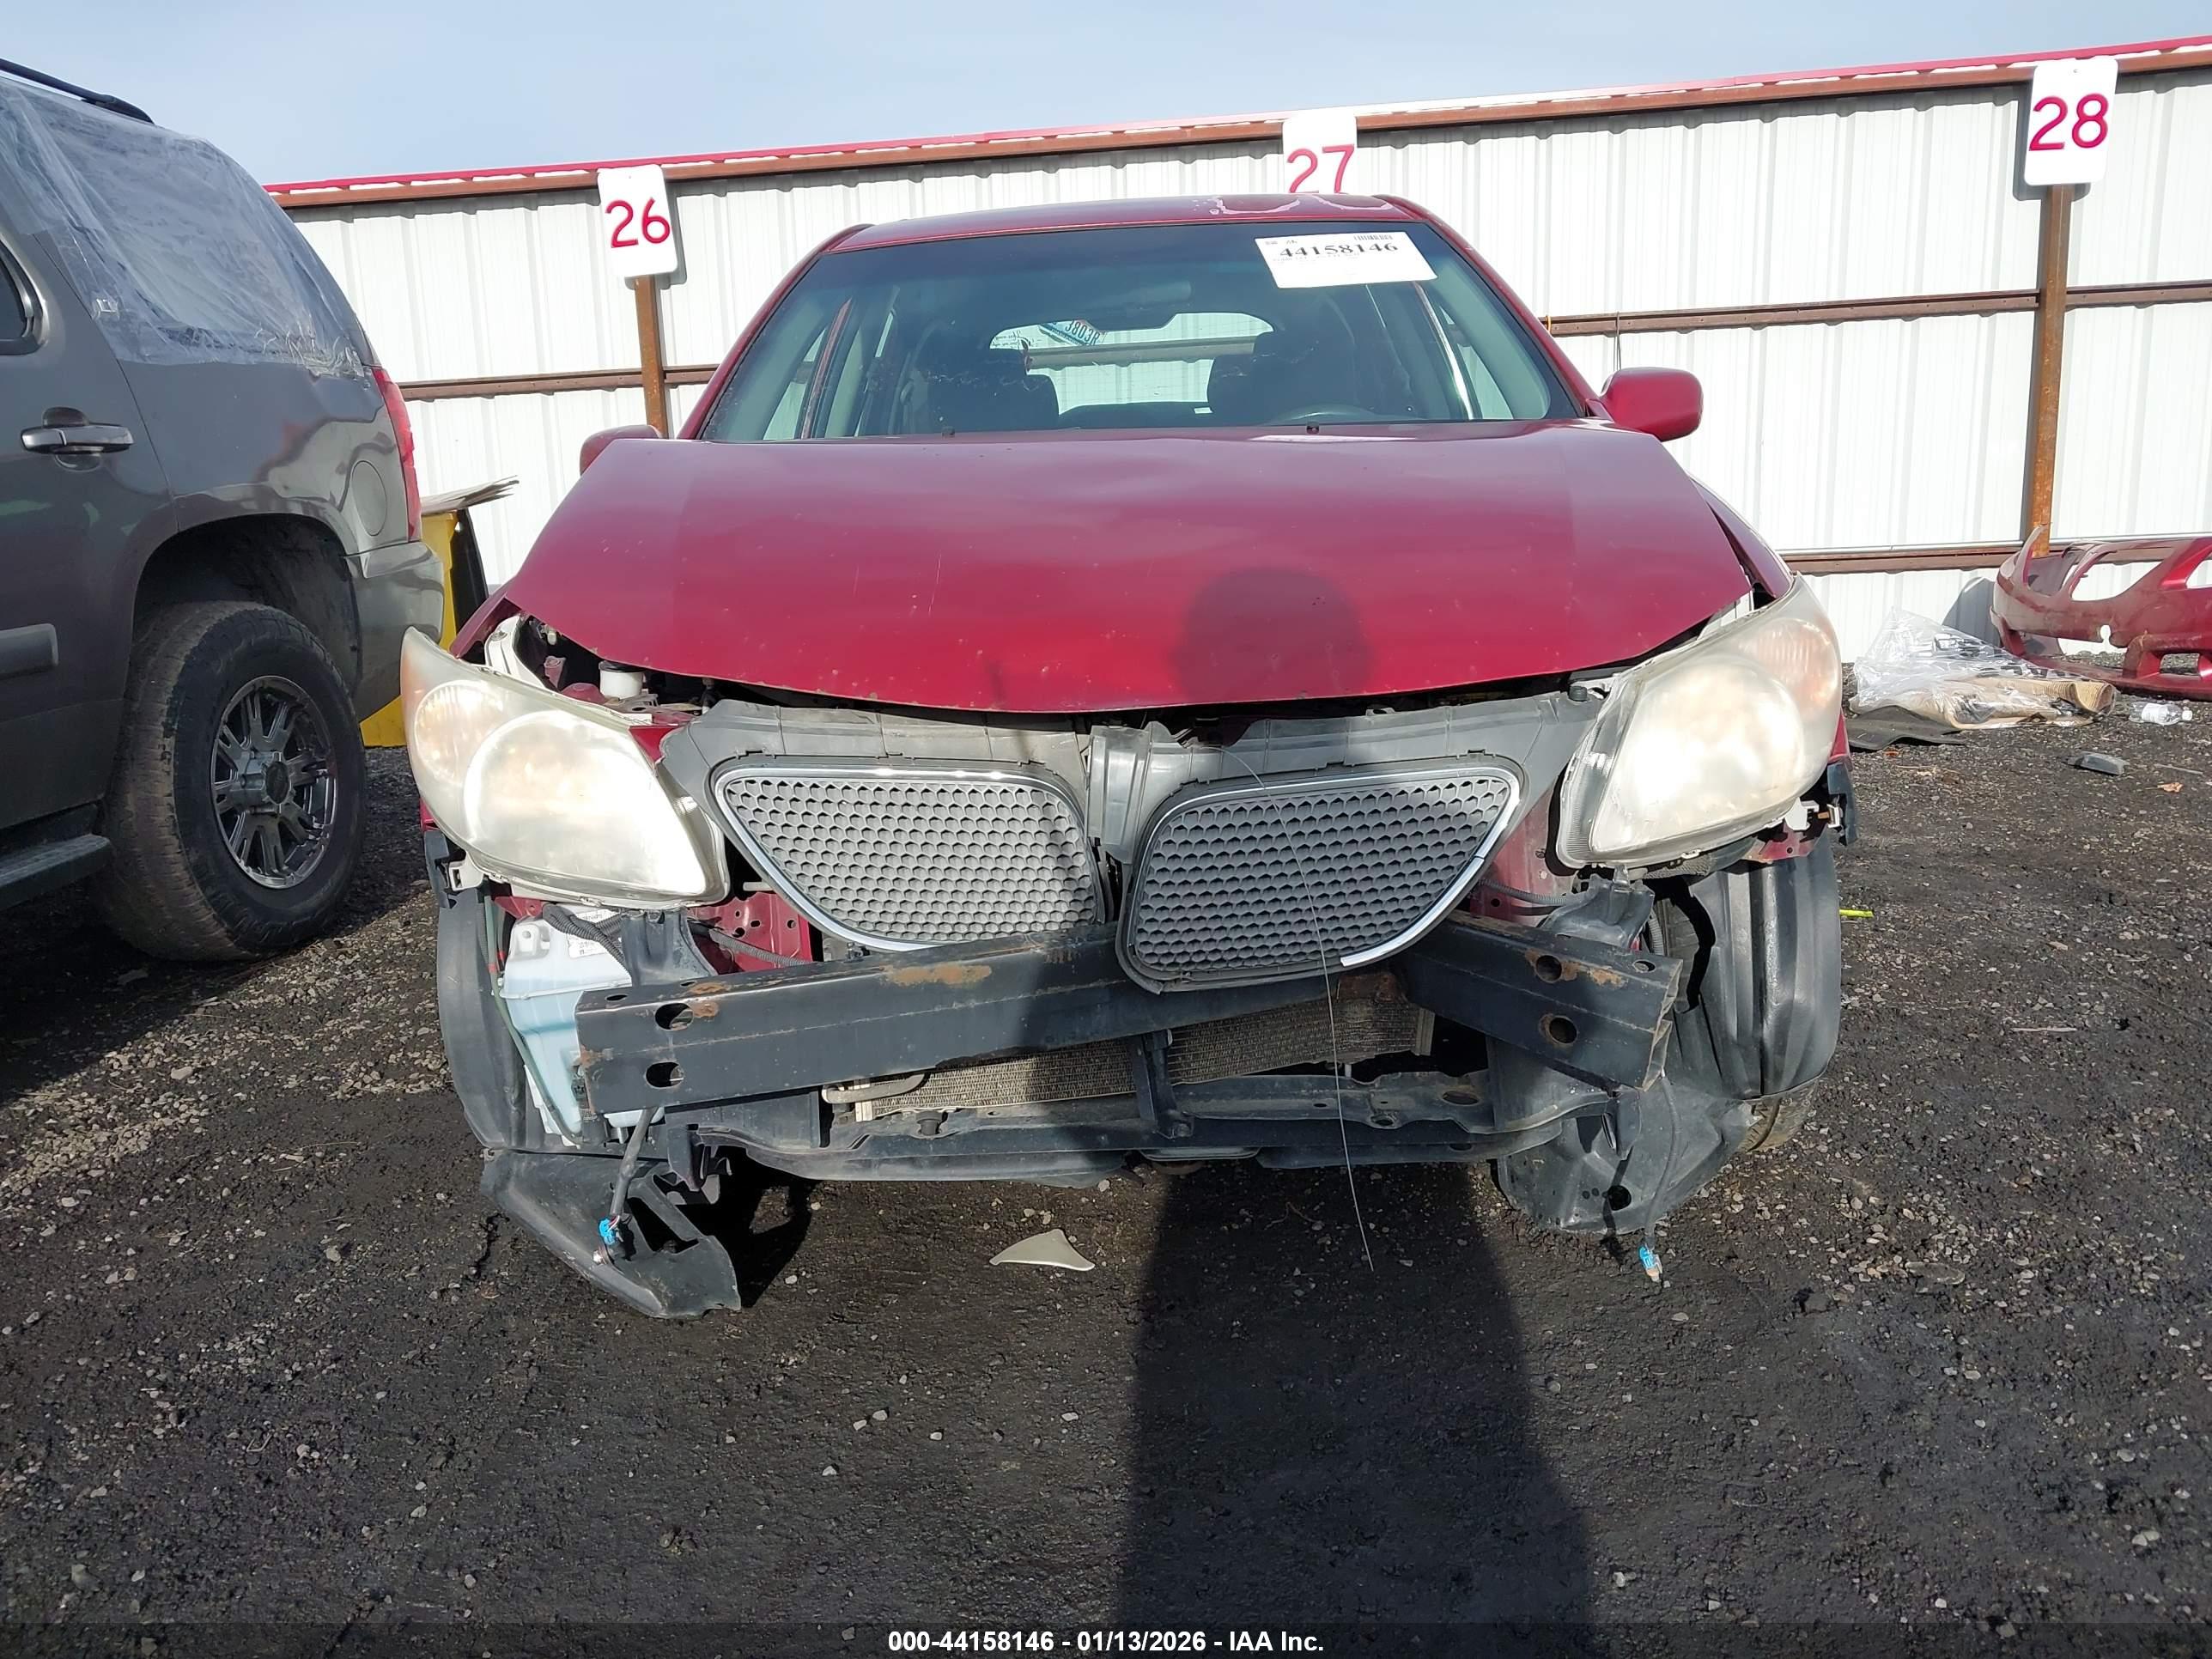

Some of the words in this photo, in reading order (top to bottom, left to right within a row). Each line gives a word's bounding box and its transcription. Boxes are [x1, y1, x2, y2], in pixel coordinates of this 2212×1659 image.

[2028, 92, 2109, 152] 28
[1287, 143, 1355, 193] 27
[605, 198, 671, 248] 26
[1279, 242, 1399, 258] 44158146
